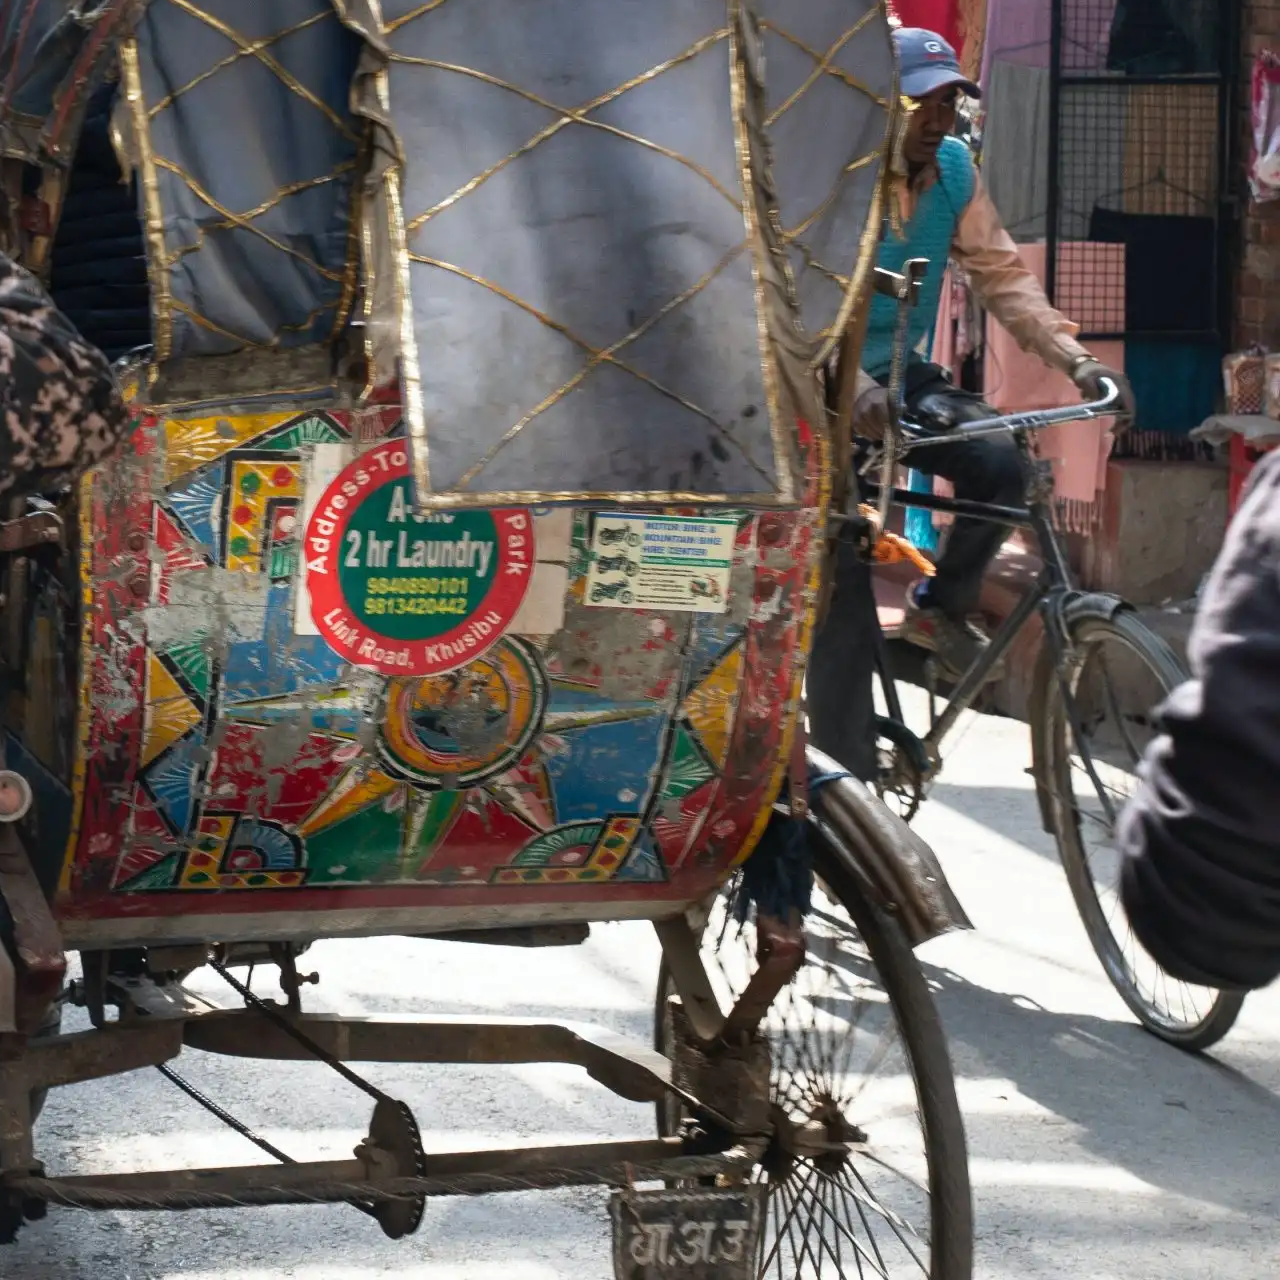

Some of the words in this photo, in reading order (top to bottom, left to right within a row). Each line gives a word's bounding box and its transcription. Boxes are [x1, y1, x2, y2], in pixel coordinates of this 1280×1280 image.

[343, 529, 361, 568] 2
[366, 529, 394, 568] hr
[396, 530, 494, 578] Laundry
[504, 513, 529, 576] Park
[322, 607, 355, 649] Link
[423, 610, 502, 664] Khusibu
